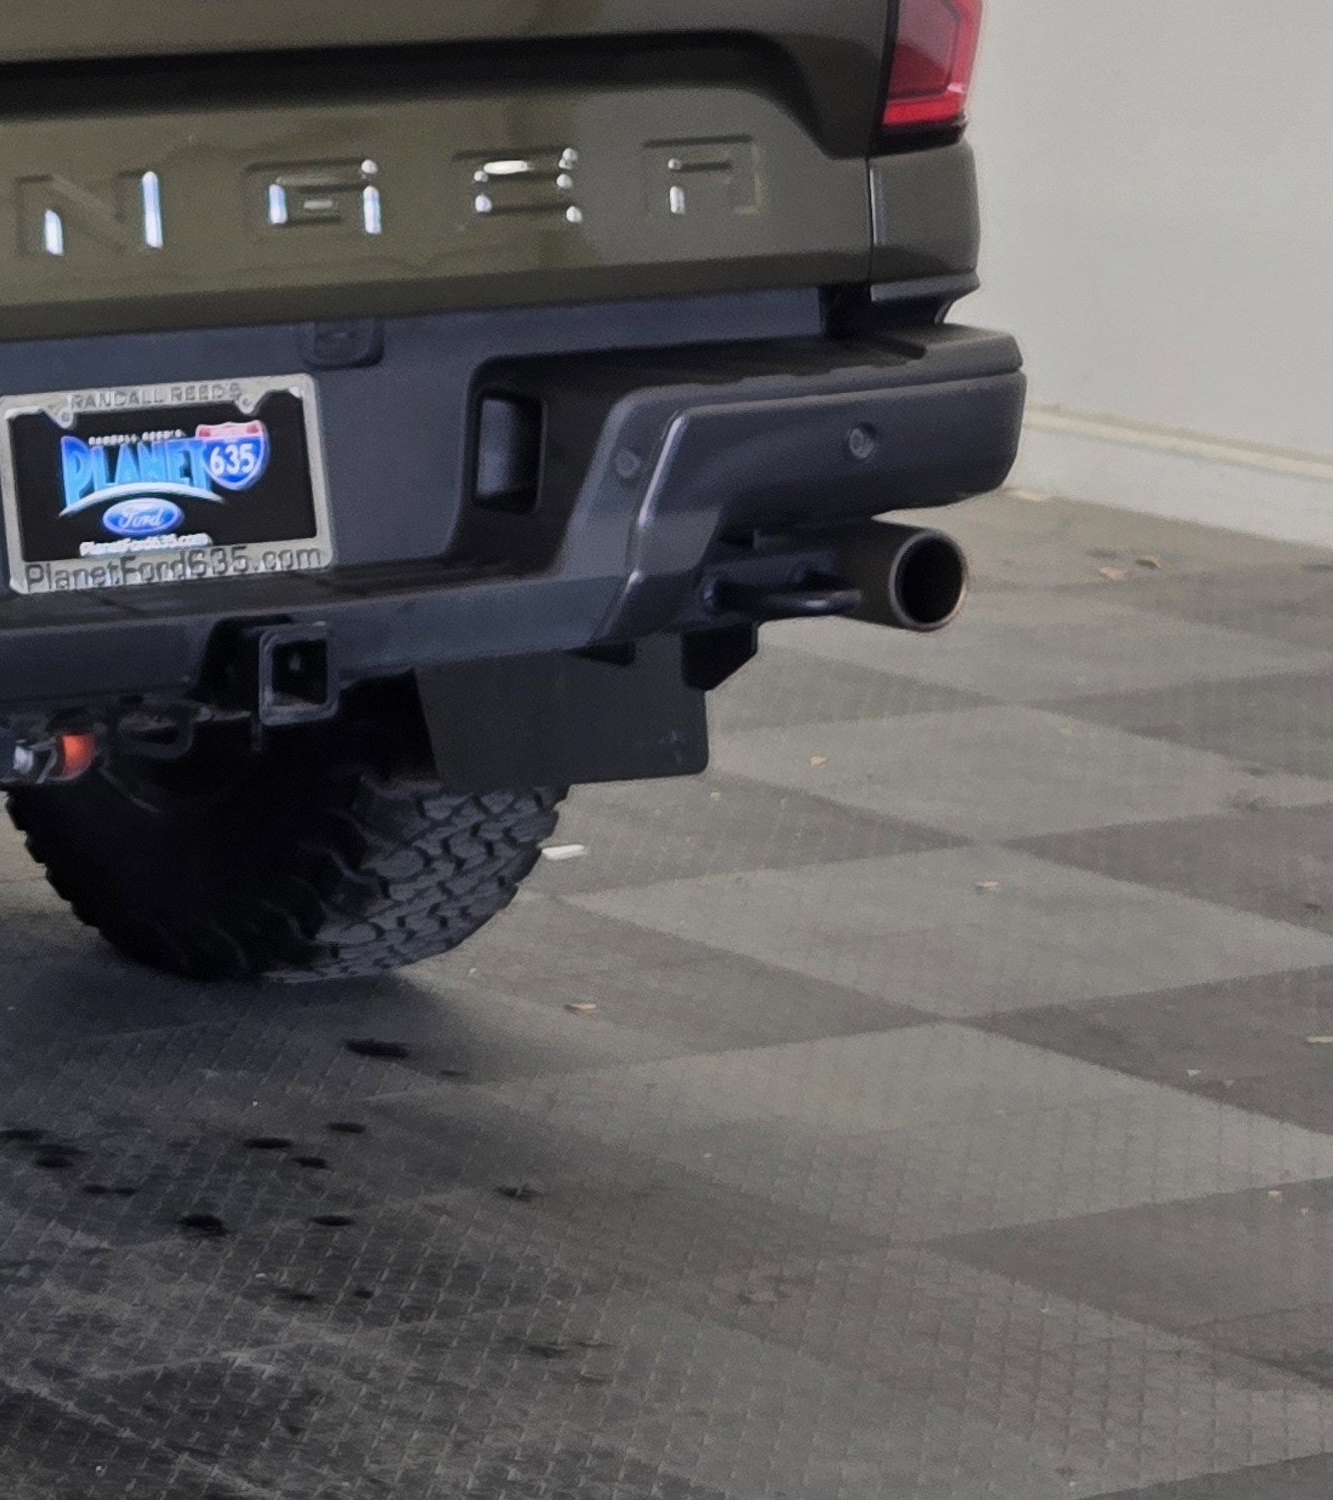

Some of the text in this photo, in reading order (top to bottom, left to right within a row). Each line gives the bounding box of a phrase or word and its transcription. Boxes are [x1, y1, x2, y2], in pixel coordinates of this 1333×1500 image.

[70, 387, 164, 411] RANDALL
[60, 436, 255, 508] PLANET 635
[117, 506, 165, 530] Ford
[25, 546, 321, 591] PlanetFord635.com
